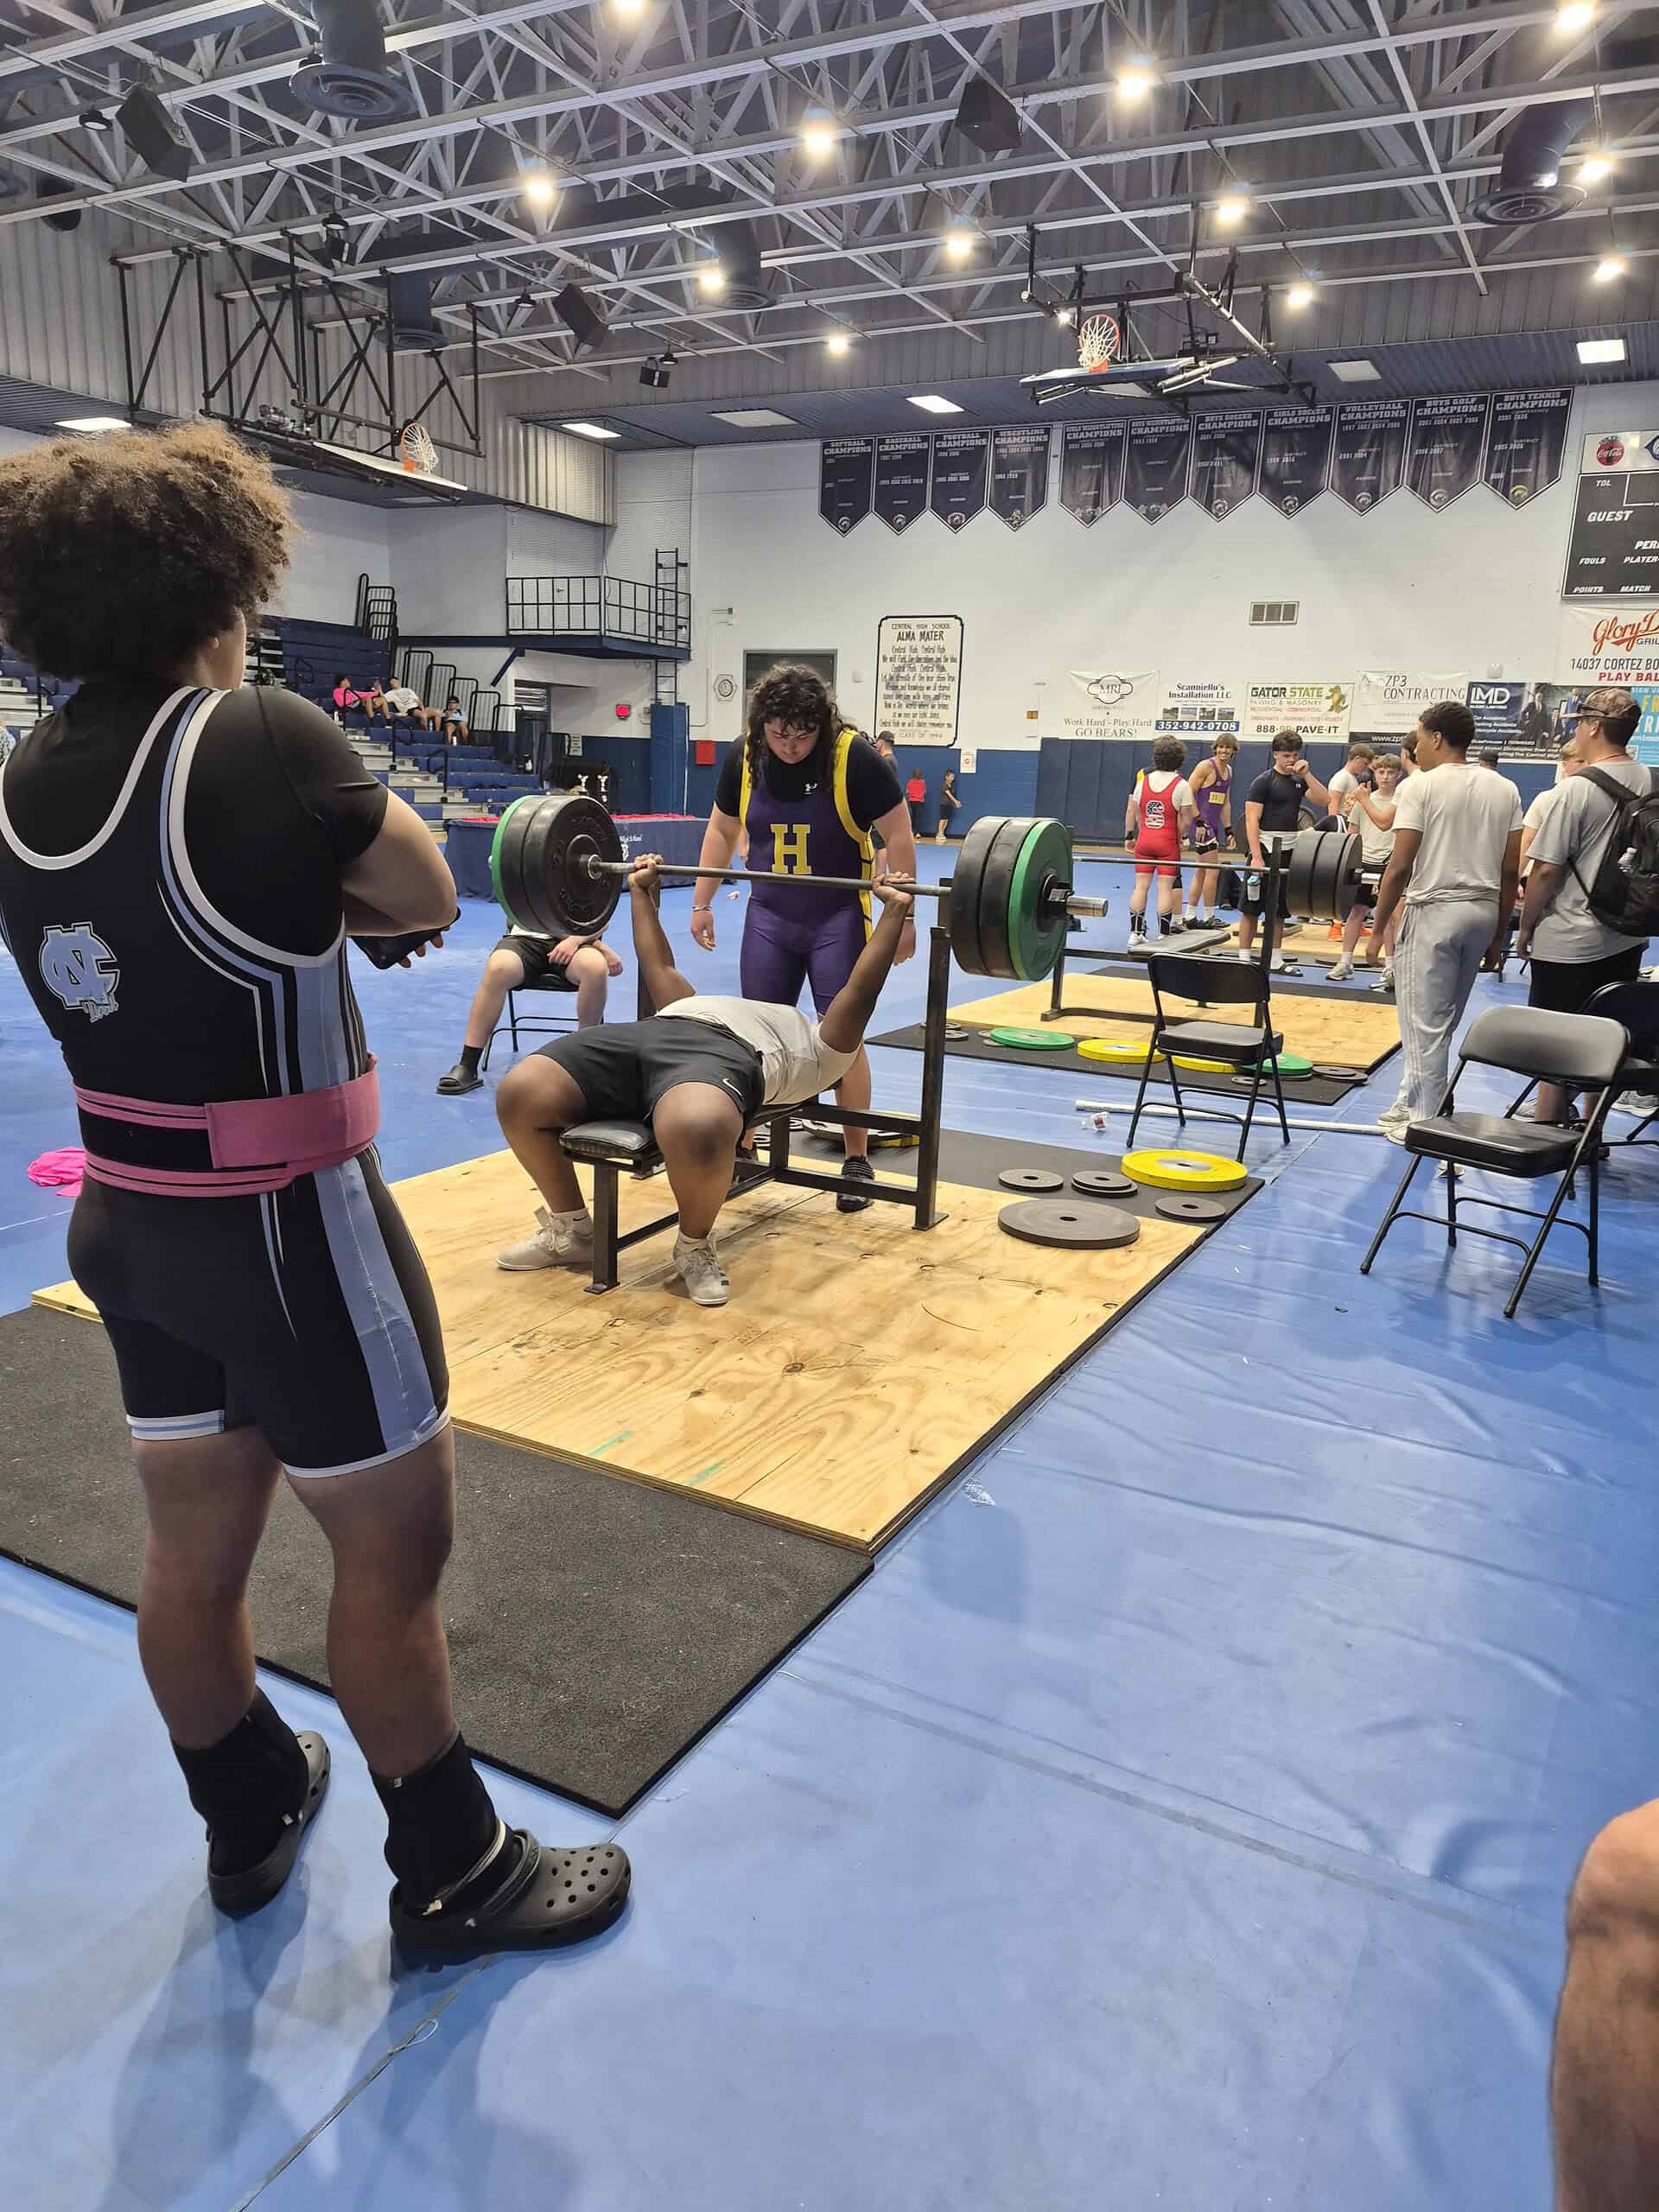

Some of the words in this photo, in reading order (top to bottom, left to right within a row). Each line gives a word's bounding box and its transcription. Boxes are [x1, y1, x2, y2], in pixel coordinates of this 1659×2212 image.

[1345, 403, 1404, 412] VOLLEYBALL
[1496, 398, 1568, 410] CHAMPIONS
[1340, 410, 1407, 421] CHAMPIONS
[1416, 404, 1485, 416] CHAMPIONS
[1198, 420, 1259, 430] CHAMPIONS
[1268, 415, 1331, 426] CHAMPIONS
[1066, 429, 1123, 440] CHAMPIONS
[1131, 423, 1189, 435] CHAMPIONS
[936, 438, 988, 448] CHAMPIONS
[995, 435, 1049, 444] CHAMPIONS
[823, 446, 872, 455] CHAMPIONS
[879, 442, 929, 451] CHAMPIONS
[1587, 511, 1633, 523] GUEST
[1634, 540, 1659, 550] PER
[897, 631, 916, 642] ALMA
[918, 630, 944, 642] MATER
[1592, 616, 1642, 656] Glory
[1571, 658, 1601, 671] 14037
[1604, 658, 1643, 670] CORTEZ
[1385, 675, 1408, 687] ZP3
[1598, 672, 1631, 681] PLAY
[1250, 687, 1287, 697] GATOR
[1289, 687, 1324, 697] STATE
[1384, 688, 1466, 699] CONTRACTING
[1470, 687, 1510, 704] LMD
[1086, 718, 1105, 727] Hard
[1113, 719, 1128, 728] Play
[1132, 718, 1153, 727] Hard
[1158, 721, 1236, 730] 352-942-0708
[1075, 728, 1092, 737] GO
[1096, 728, 1138, 737] BEARS!
[771, 823, 811, 874] H
